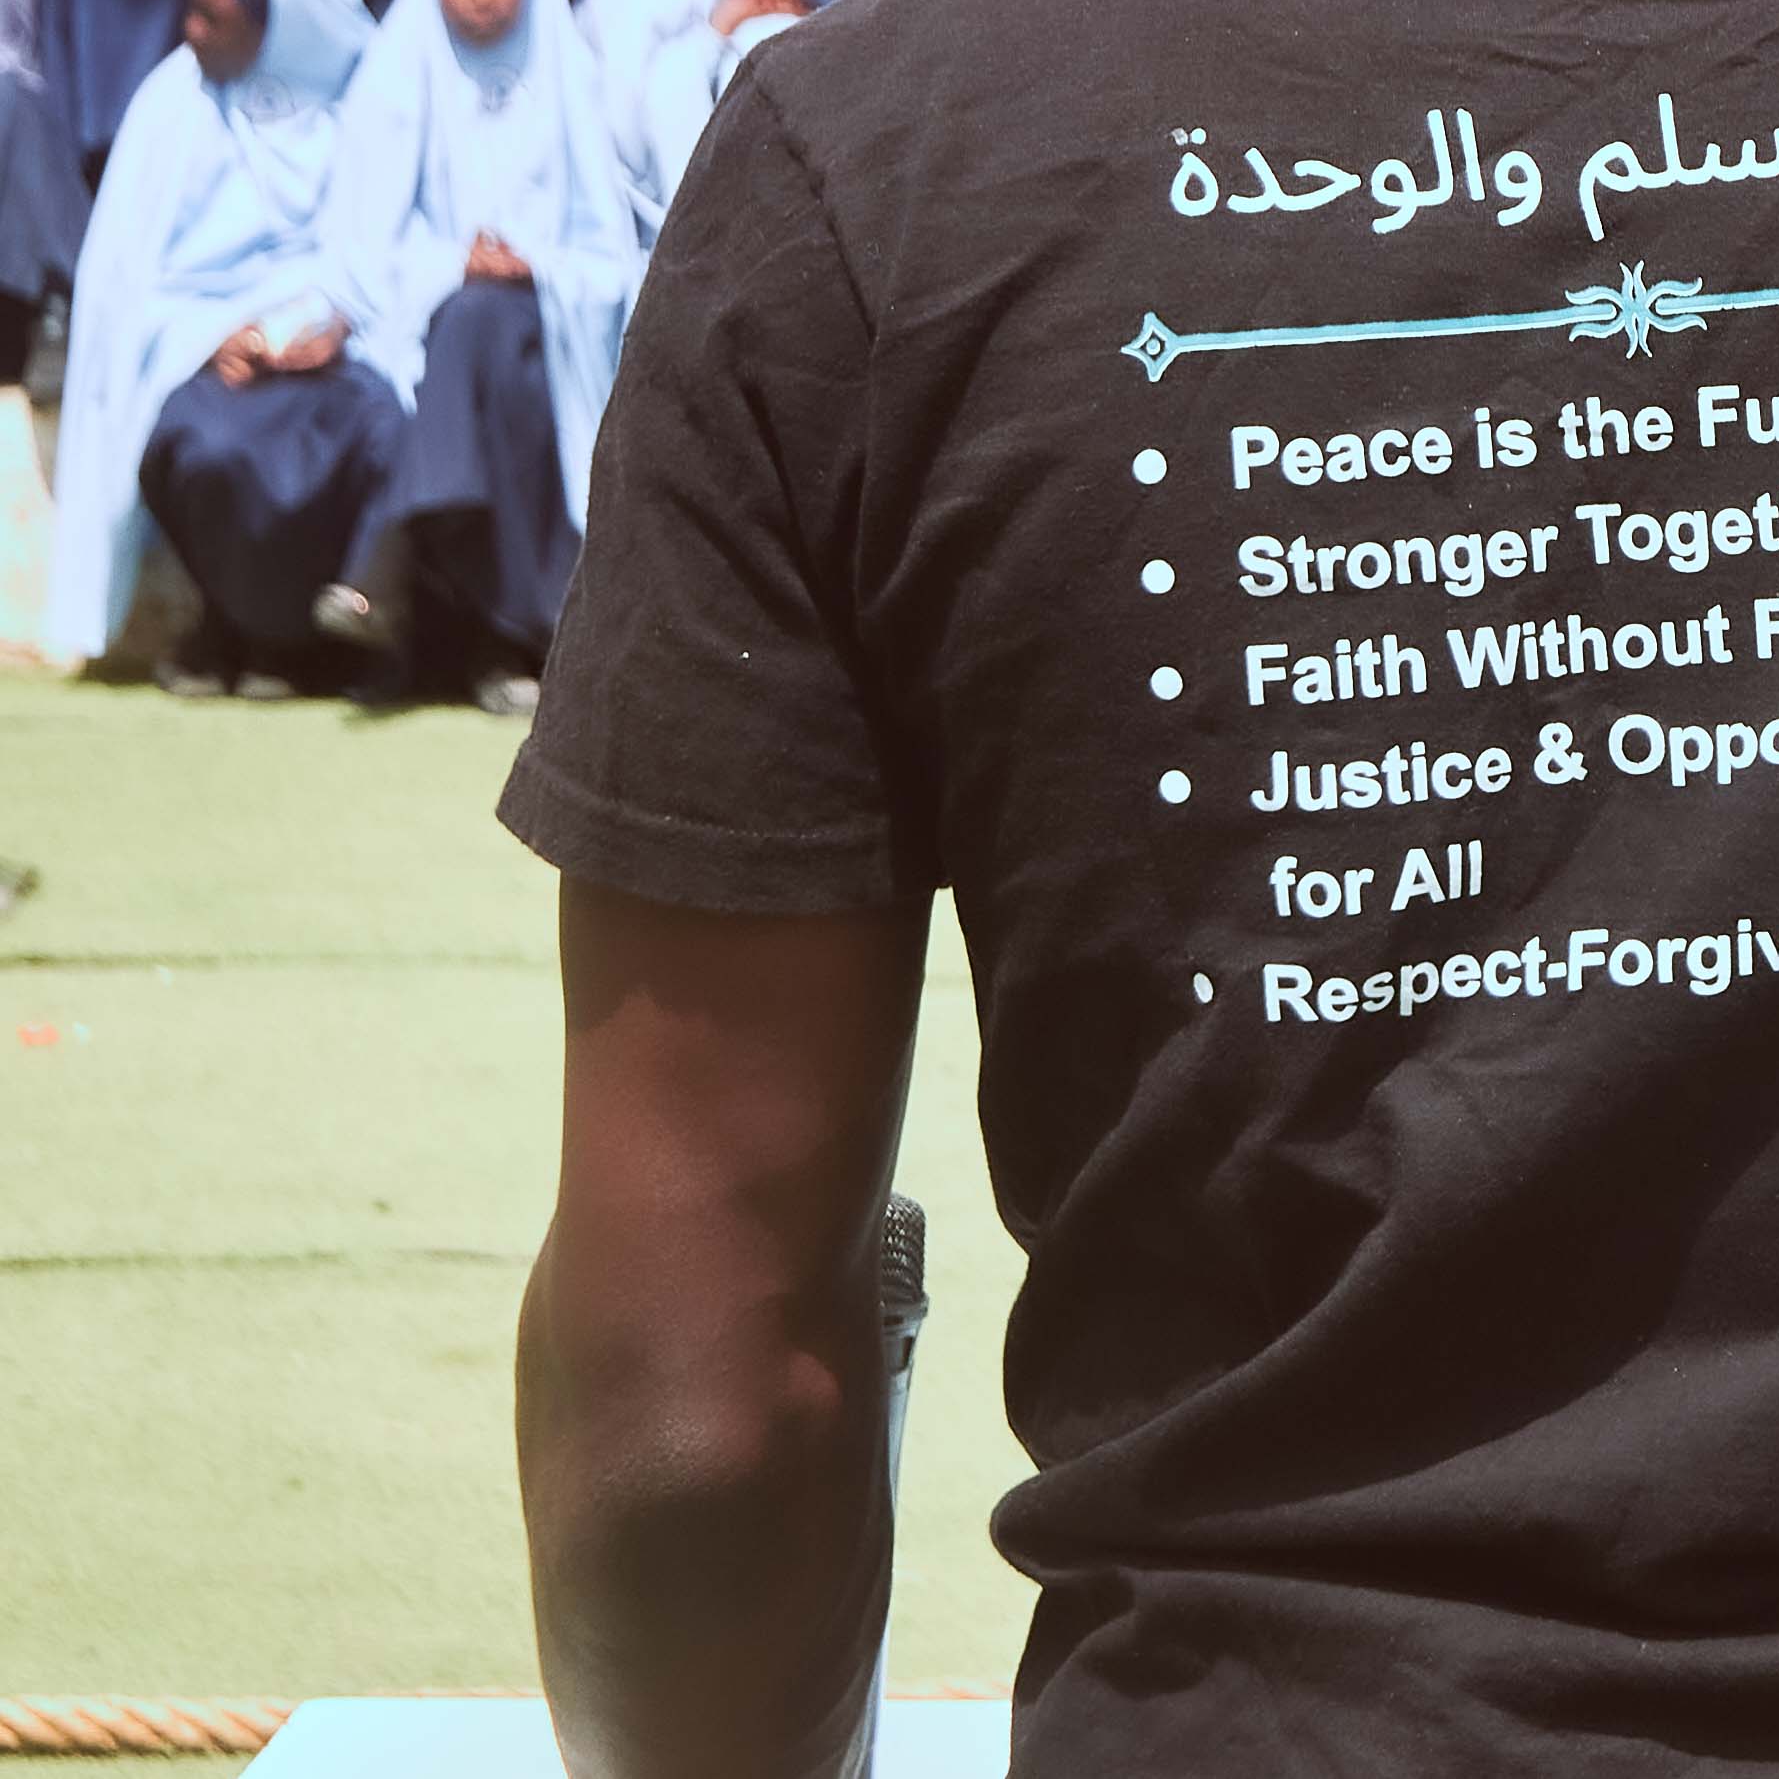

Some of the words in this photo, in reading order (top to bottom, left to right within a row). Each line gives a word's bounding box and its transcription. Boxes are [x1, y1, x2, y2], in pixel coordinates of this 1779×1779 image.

[1169, 108, 1543, 235] والوحدة
[1230, 425, 1453, 490] Peace
[1474, 407, 1538, 469] is
[1558, 396, 1674, 460] the
[1238, 525, 1559, 598] Stronger
[1245, 634, 1427, 706] Faith
[1446, 604, 1734, 689] Without
[1250, 741, 1512, 812] Justice
[1533, 722, 1588, 785] &
[1269, 855, 1375, 918] for
[1390, 839, 1483, 911] All
